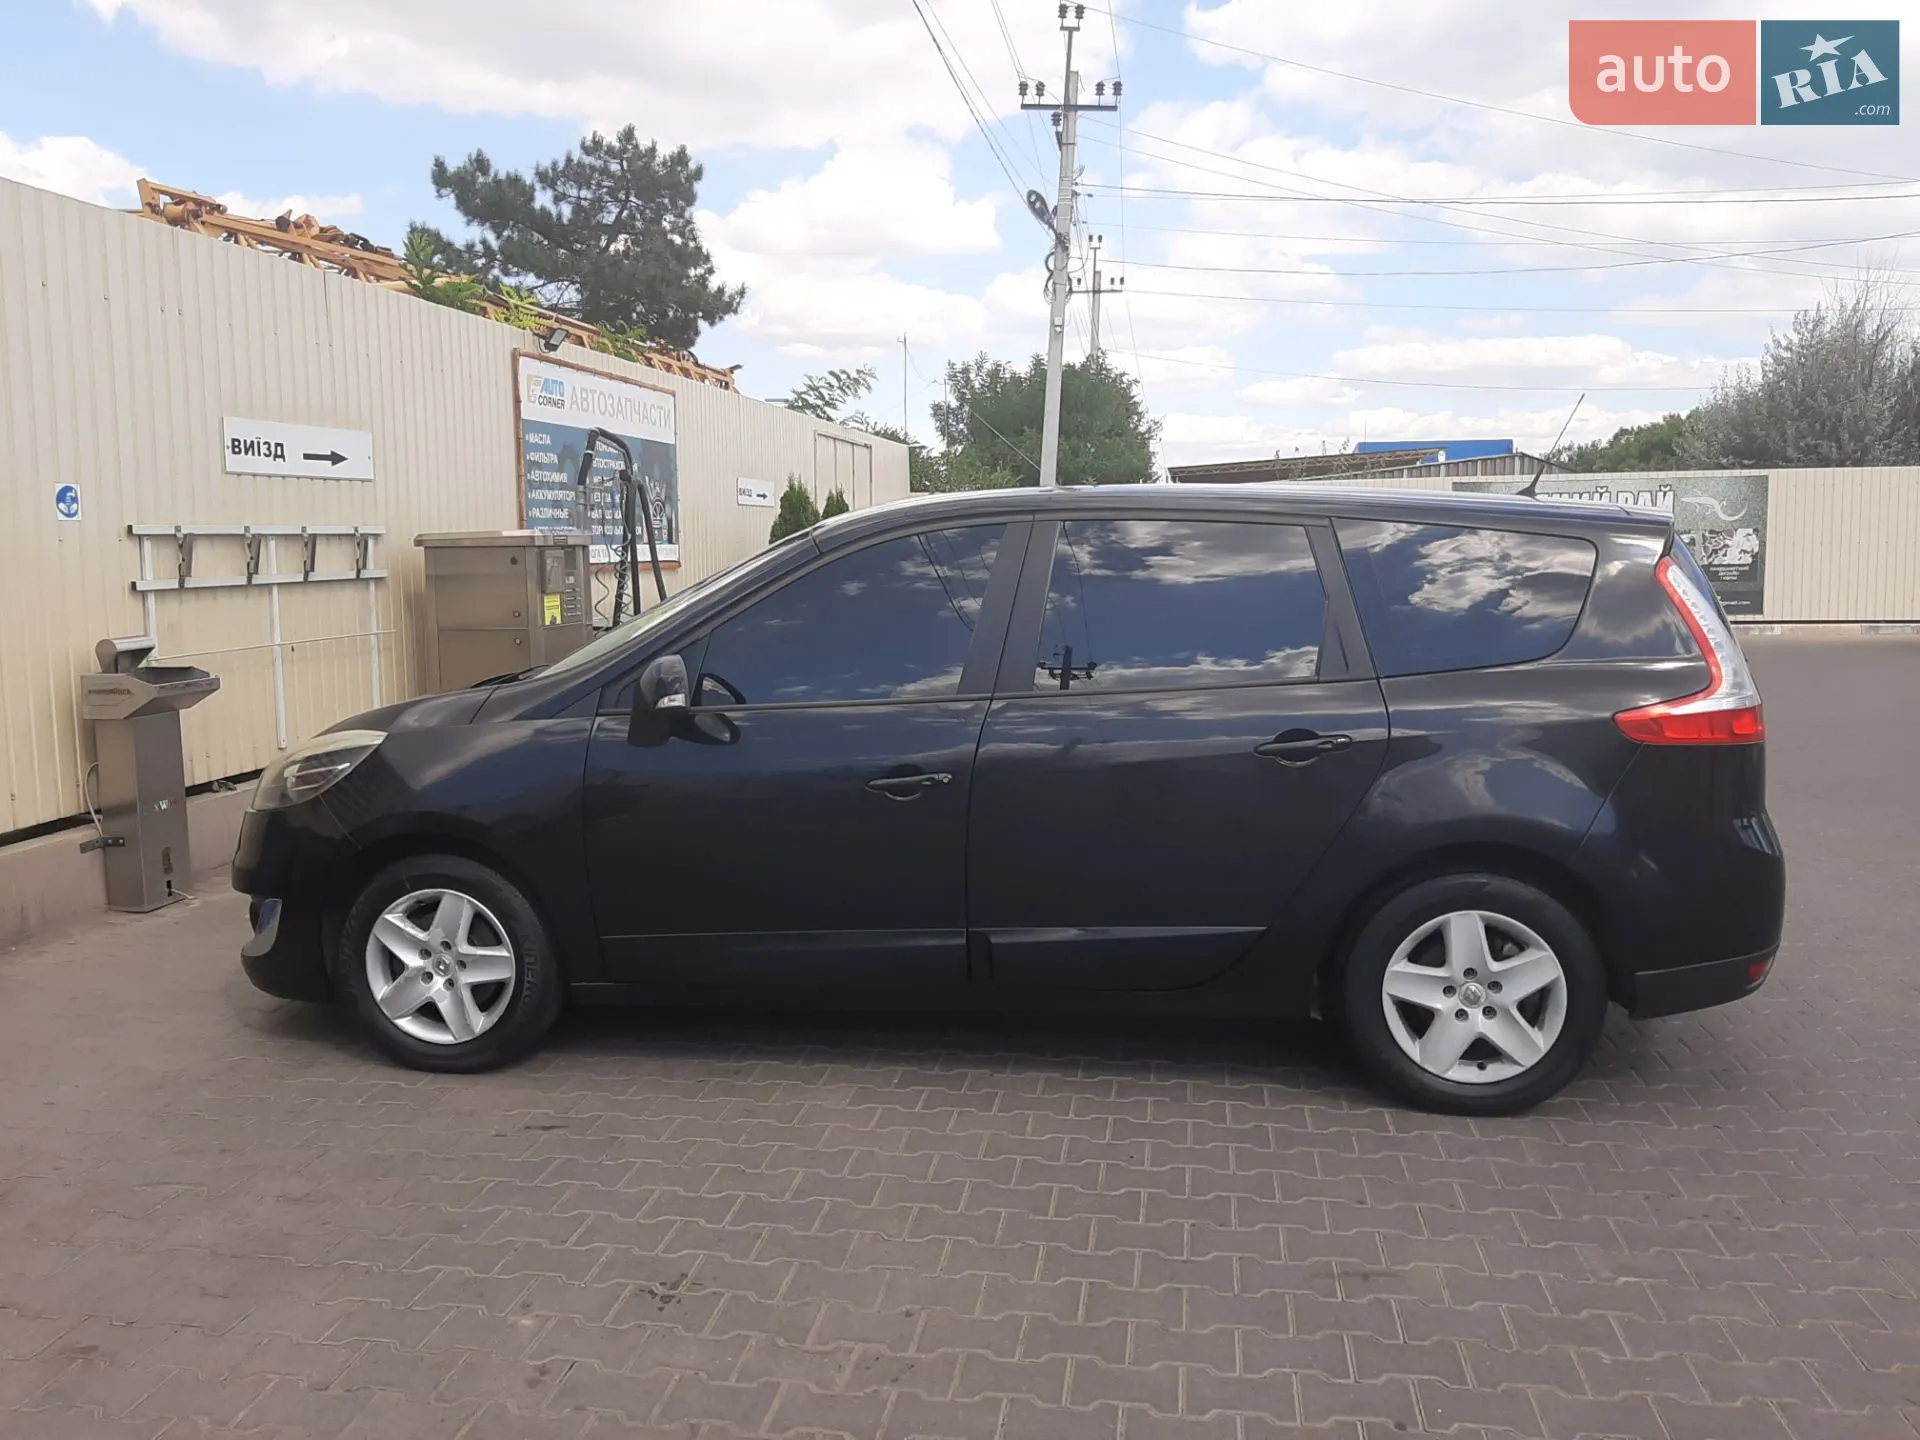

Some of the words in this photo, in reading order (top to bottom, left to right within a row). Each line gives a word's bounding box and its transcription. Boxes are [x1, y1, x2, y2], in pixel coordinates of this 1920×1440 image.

[540, 377, 565, 397] AUTO
[538, 395, 565, 410] CORNER
[569, 385, 671, 430] АВТОЗАПЧАСТИ
[528, 432, 551, 446] МАСЛА
[231, 436, 286, 462] ВИЇЗД
[530, 451, 559, 465] ФИЛЬТРА
[531, 470, 568, 483] АВТОХИМИЯ
[532, 507, 569, 519] РАЗЛИЧНЫЕ
